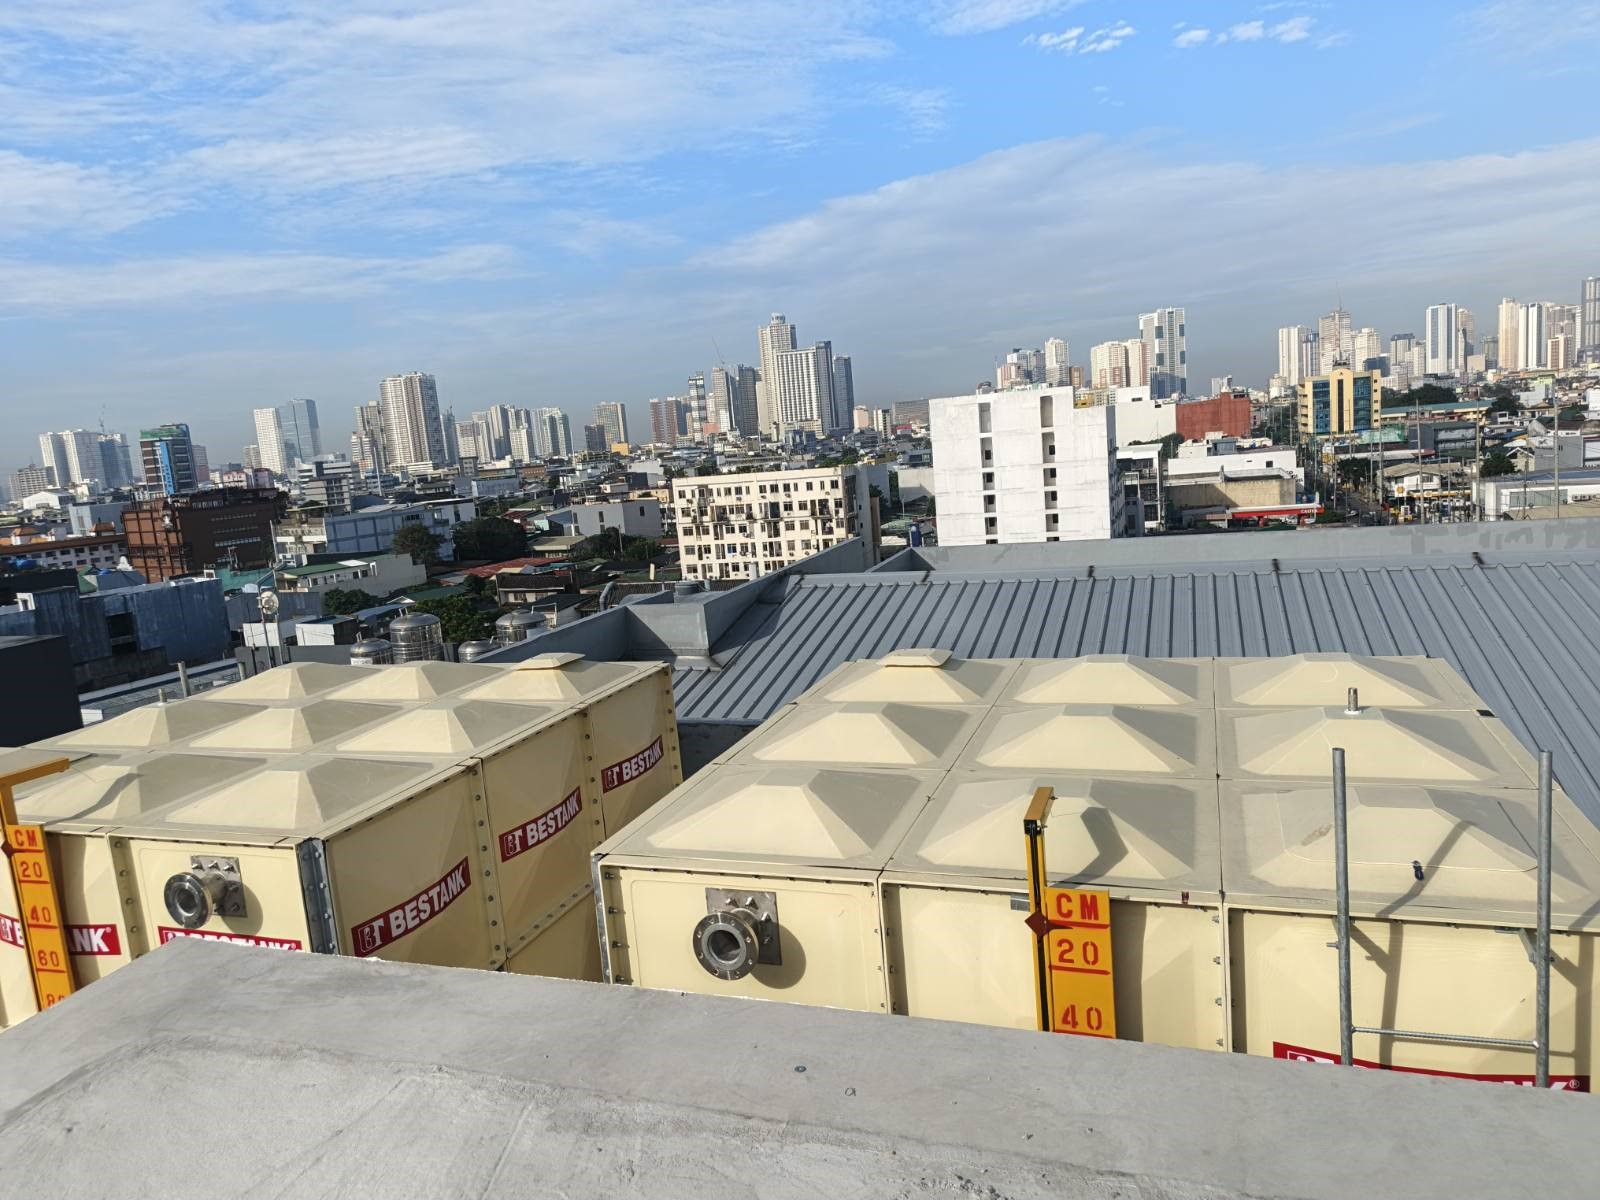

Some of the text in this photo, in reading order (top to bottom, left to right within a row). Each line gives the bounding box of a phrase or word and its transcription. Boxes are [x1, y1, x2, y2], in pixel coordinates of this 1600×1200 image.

[621, 740, 662, 781] BESTANK
[526, 792, 579, 846] BESTANK
[14, 829, 37, 847] CM
[20, 861, 42, 878] 20
[30, 905, 52, 922] 40
[389, 865, 466, 938] BESTANK
[1056, 893, 1099, 921] CM
[37, 950, 60, 967] 60
[1056, 938, 1099, 966] 20
[1061, 1004, 1103, 1031] 40
